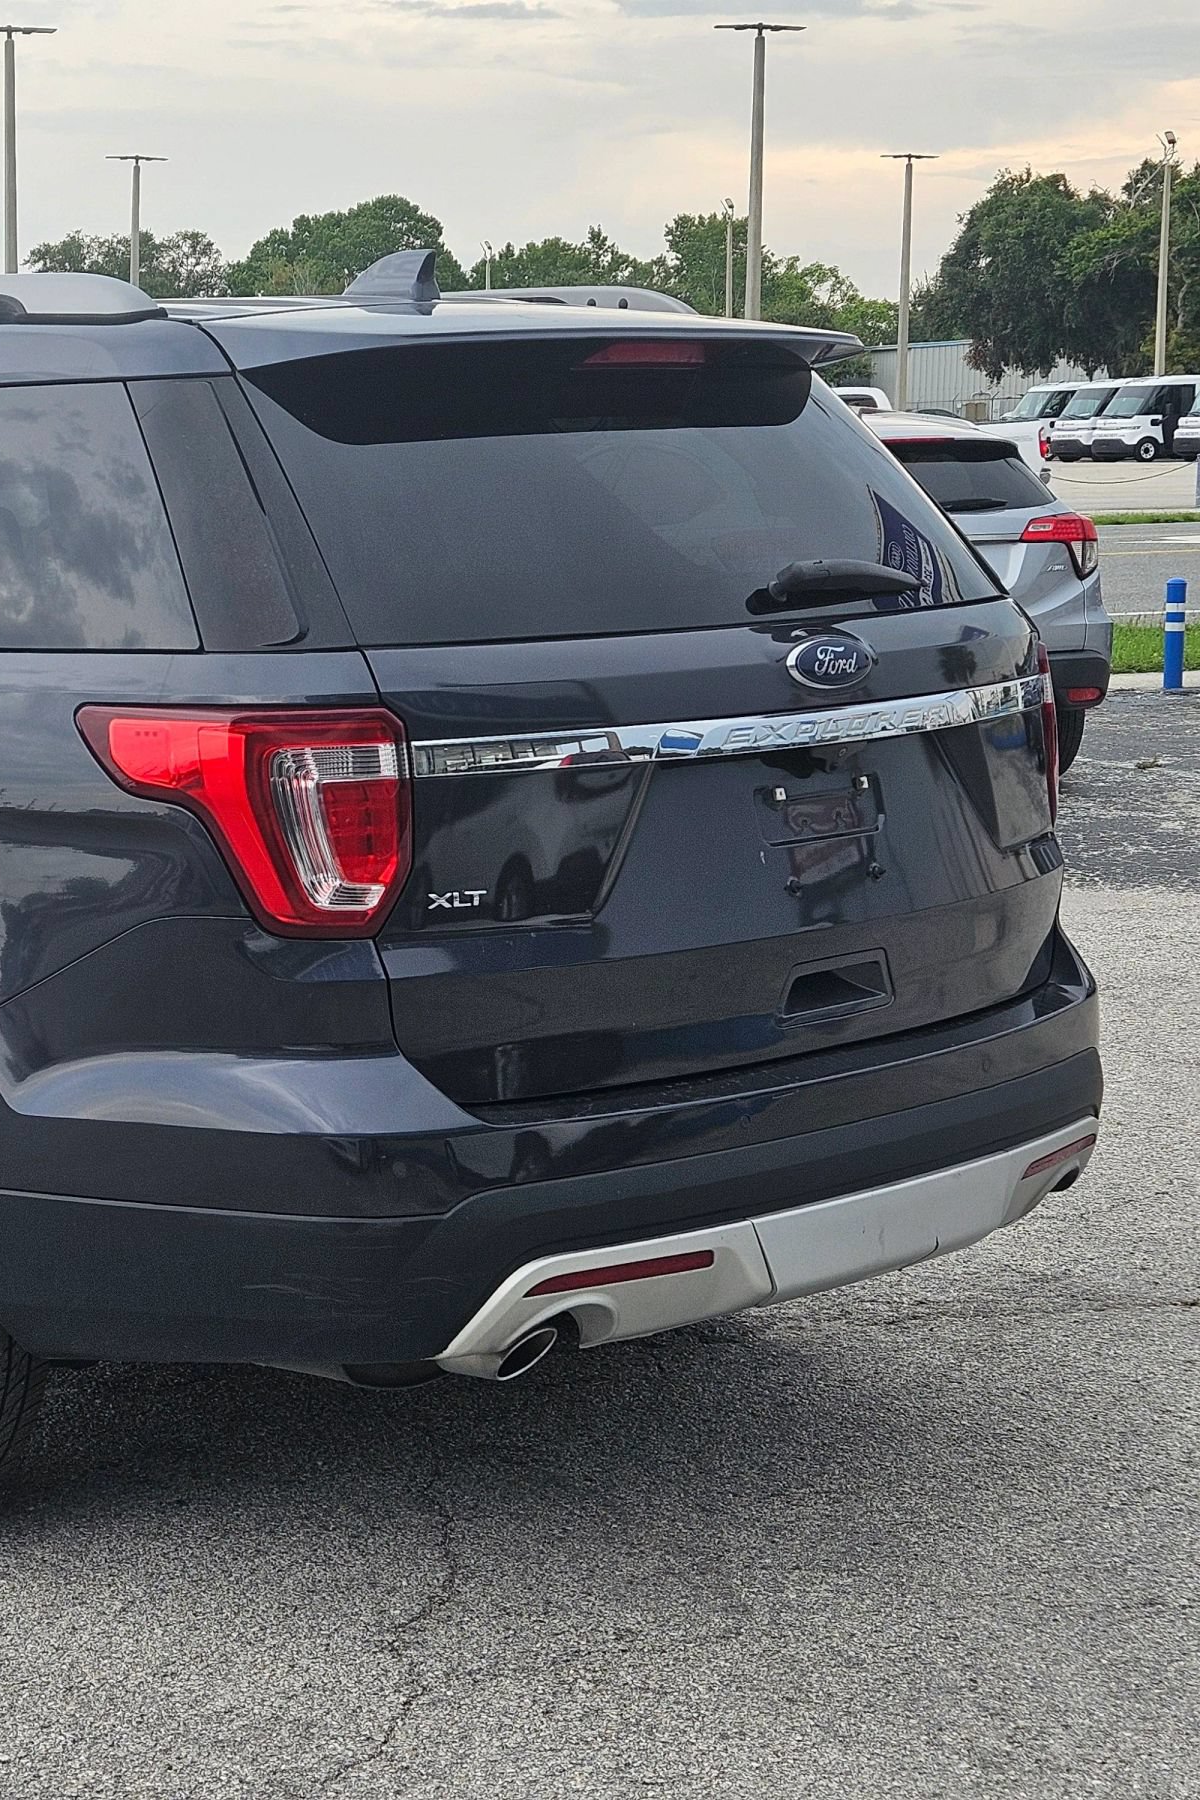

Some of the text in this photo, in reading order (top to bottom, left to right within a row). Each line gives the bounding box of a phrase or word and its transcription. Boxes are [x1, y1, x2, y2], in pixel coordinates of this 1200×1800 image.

[814, 645, 859, 676] Ford
[720, 703, 944, 750] EXPLORER
[428, 889, 487, 909] XLT
